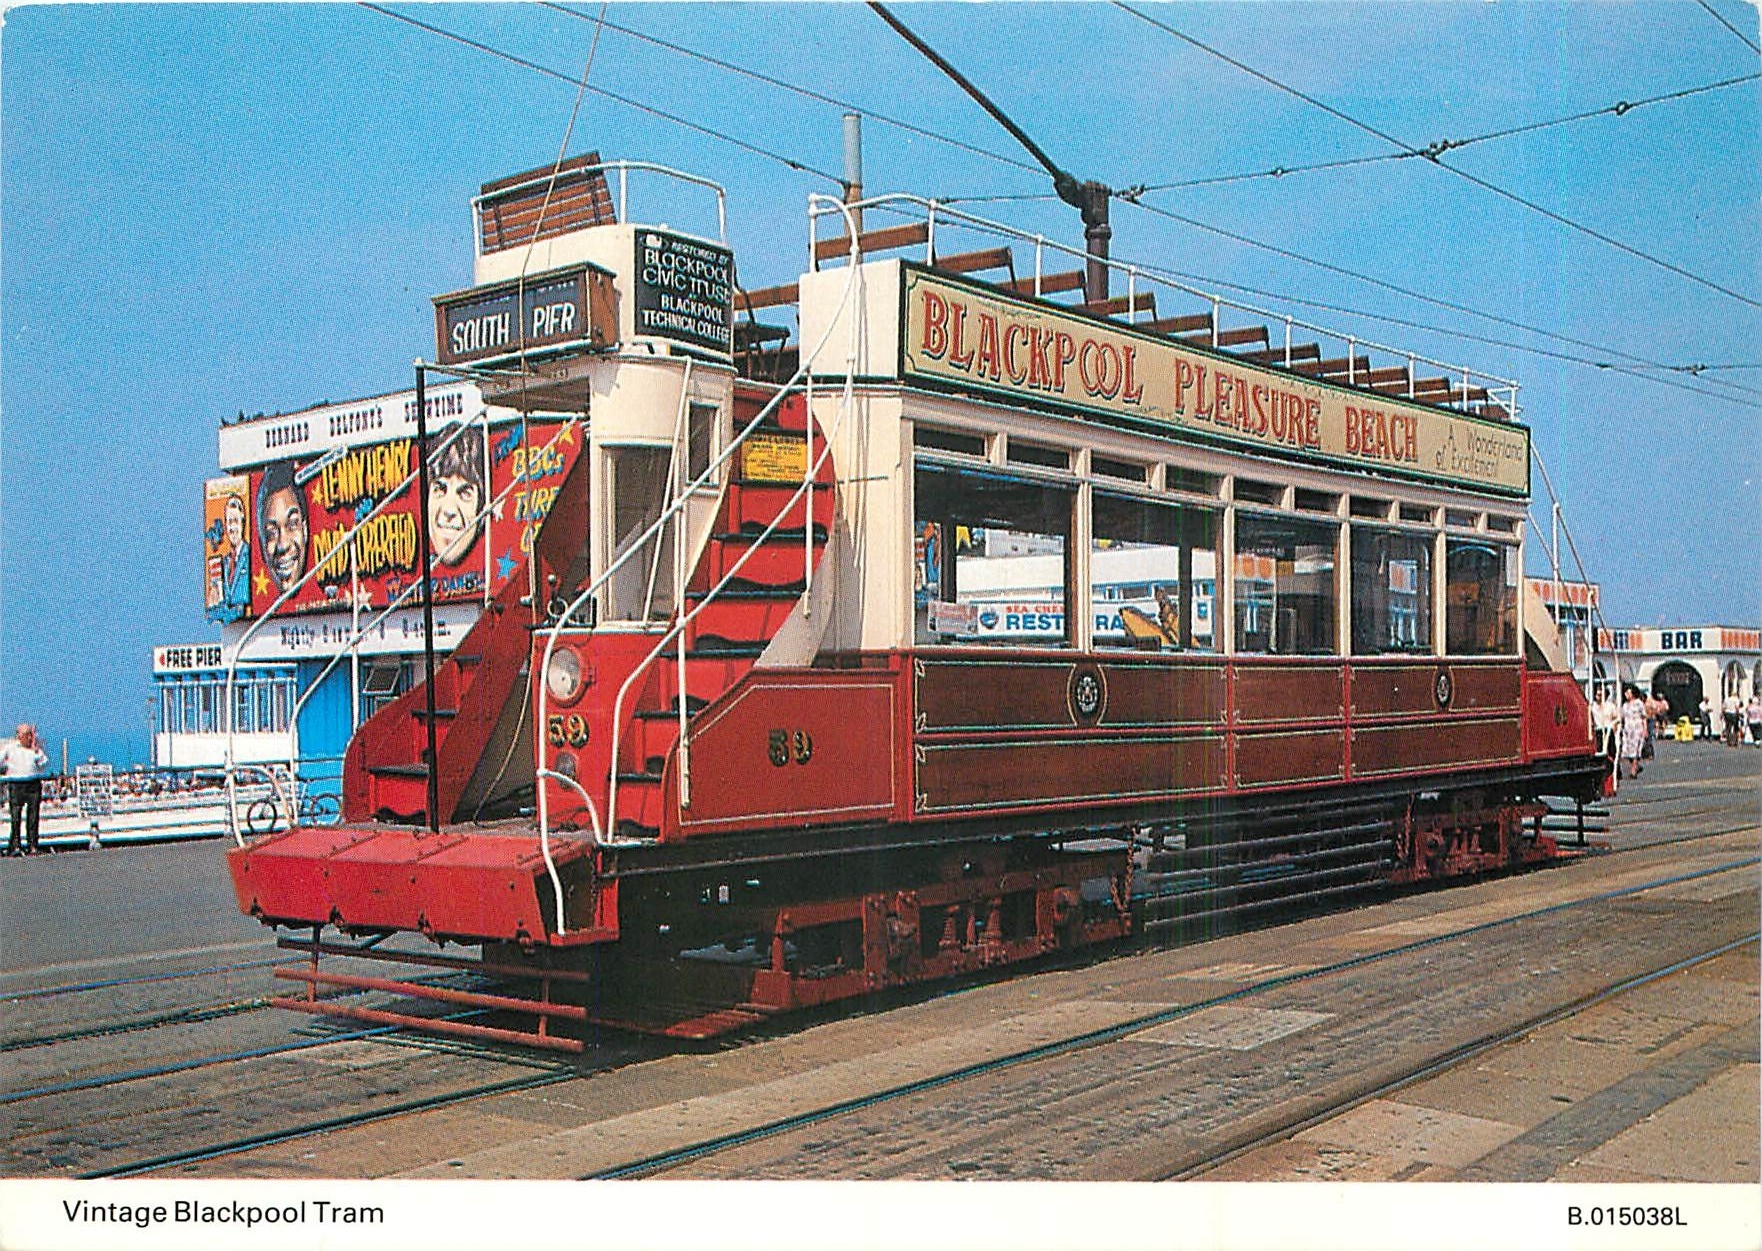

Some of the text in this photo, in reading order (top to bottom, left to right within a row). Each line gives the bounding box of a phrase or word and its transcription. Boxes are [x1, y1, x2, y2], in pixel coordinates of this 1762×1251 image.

[642, 266, 687, 291] CIVIC
[642, 309, 696, 334] TECHNICAL
[661, 293, 723, 323] BLACKPOOL
[452, 302, 576, 355] SOUTH PIER
[921, 290, 1419, 462] BLACKPOOL PLEASURE BEACH
[1448, 424, 1523, 462] A Wonderland
[321, 452, 365, 509] LENNY
[366, 438, 412, 500] HENRY
[1006, 605, 1029, 614] SEA
[166, 645, 222, 668] FREE PIER
[1661, 631, 1703, 650] BAR
[549, 713, 591, 748] 59
[767, 727, 813, 767] 59
